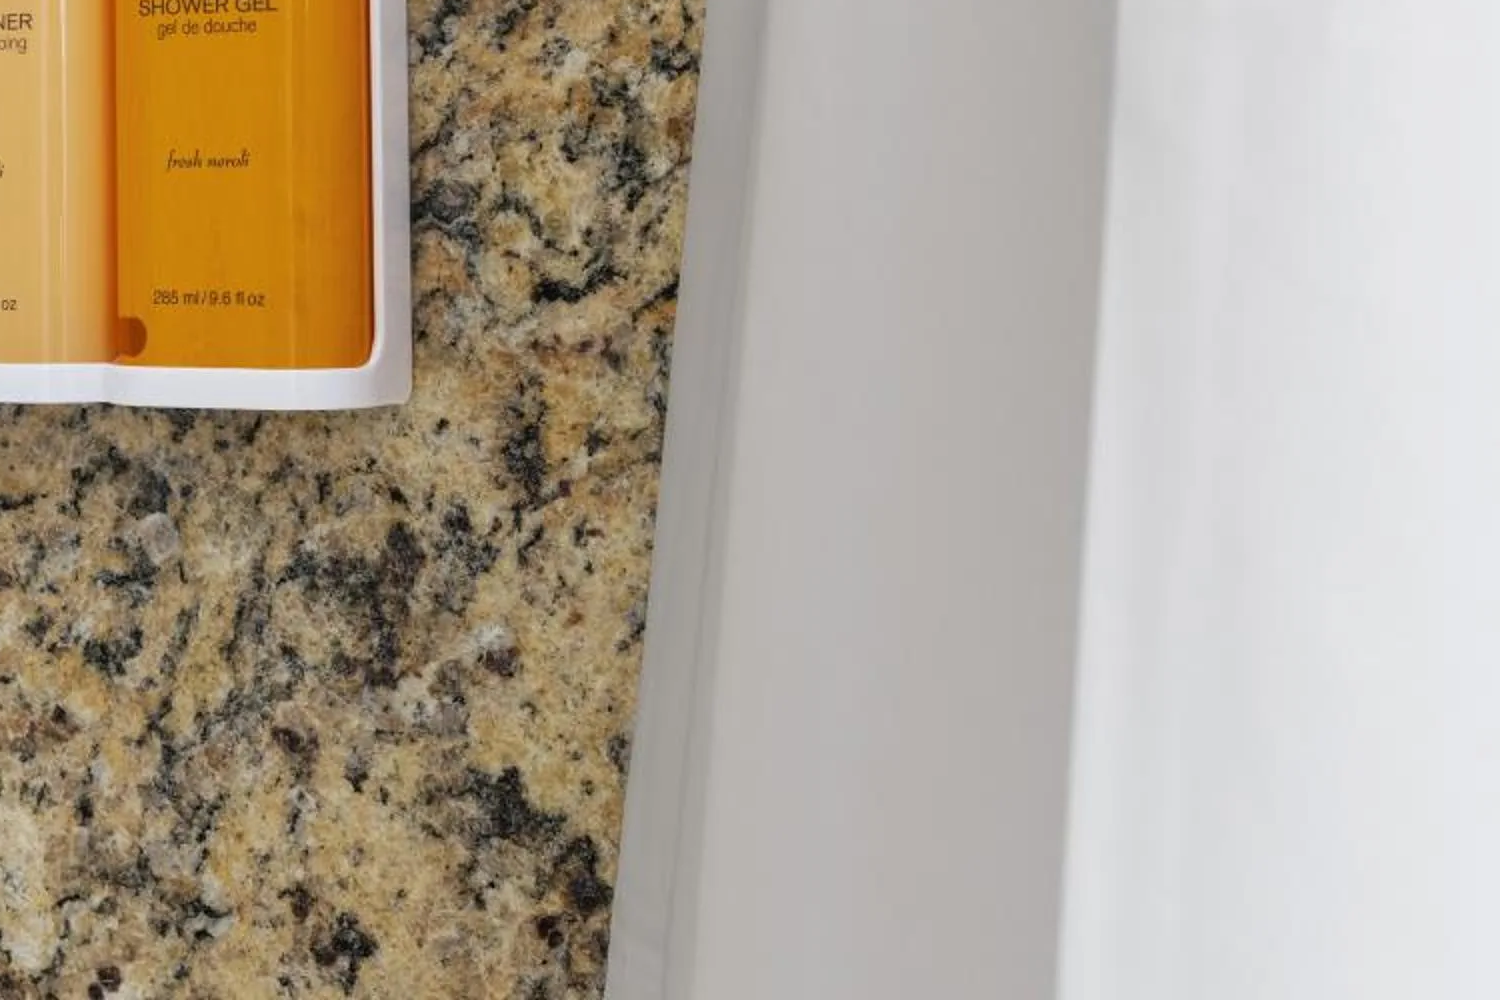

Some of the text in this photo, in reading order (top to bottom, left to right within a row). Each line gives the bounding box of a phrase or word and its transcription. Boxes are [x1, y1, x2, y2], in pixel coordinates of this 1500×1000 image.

[157, 17, 257, 41] gel de douche
[166, 147, 251, 173] fresh neroli
[2, 298, 18, 311] oz
[153, 289, 179, 306] 285
[247, 293, 266, 308] oz
